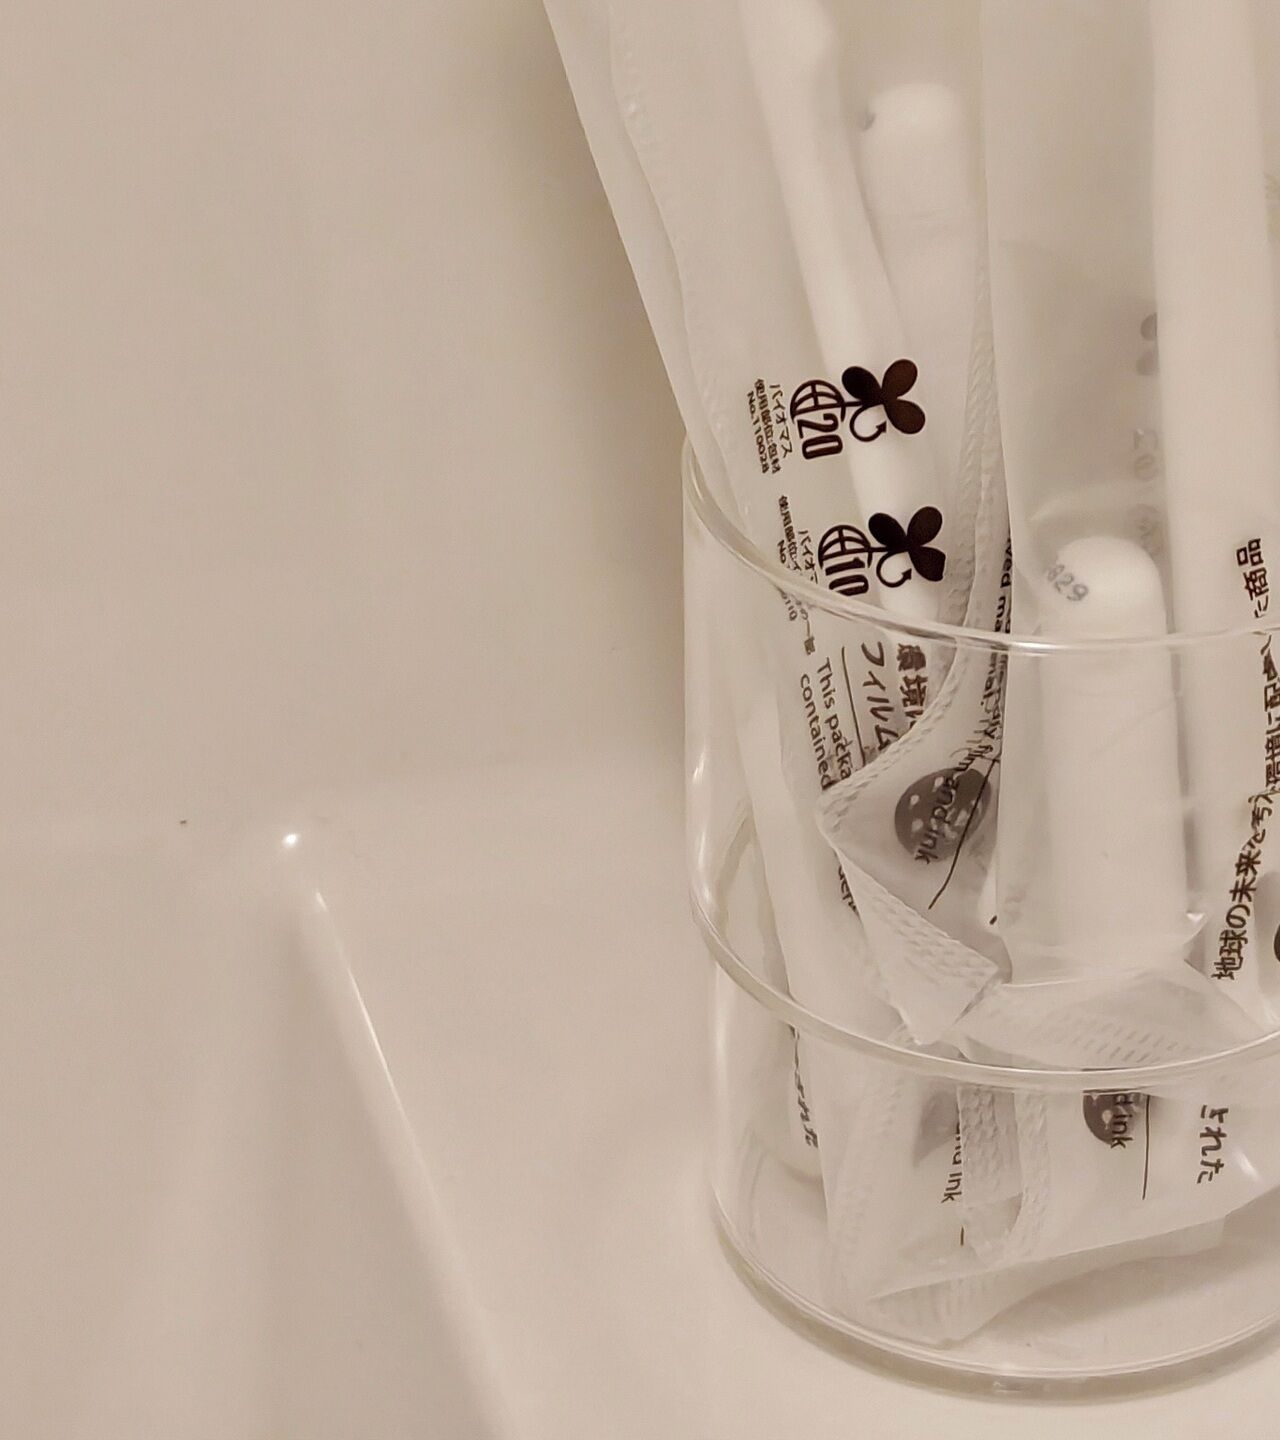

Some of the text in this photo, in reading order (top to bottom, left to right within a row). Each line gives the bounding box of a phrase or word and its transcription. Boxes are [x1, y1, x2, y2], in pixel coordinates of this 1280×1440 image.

[769, 383, 793, 459] バイオマス
[797, 412, 844, 460] 20
[798, 529, 819, 586] バイオ
[825, 556, 870, 597] 10
[816, 656, 836, 711] This
[860, 641, 899, 752] フィルム
[800, 673, 834, 792] contained
[1110, 1113, 1135, 1149] ink
[941, 1171, 963, 1204] ink
